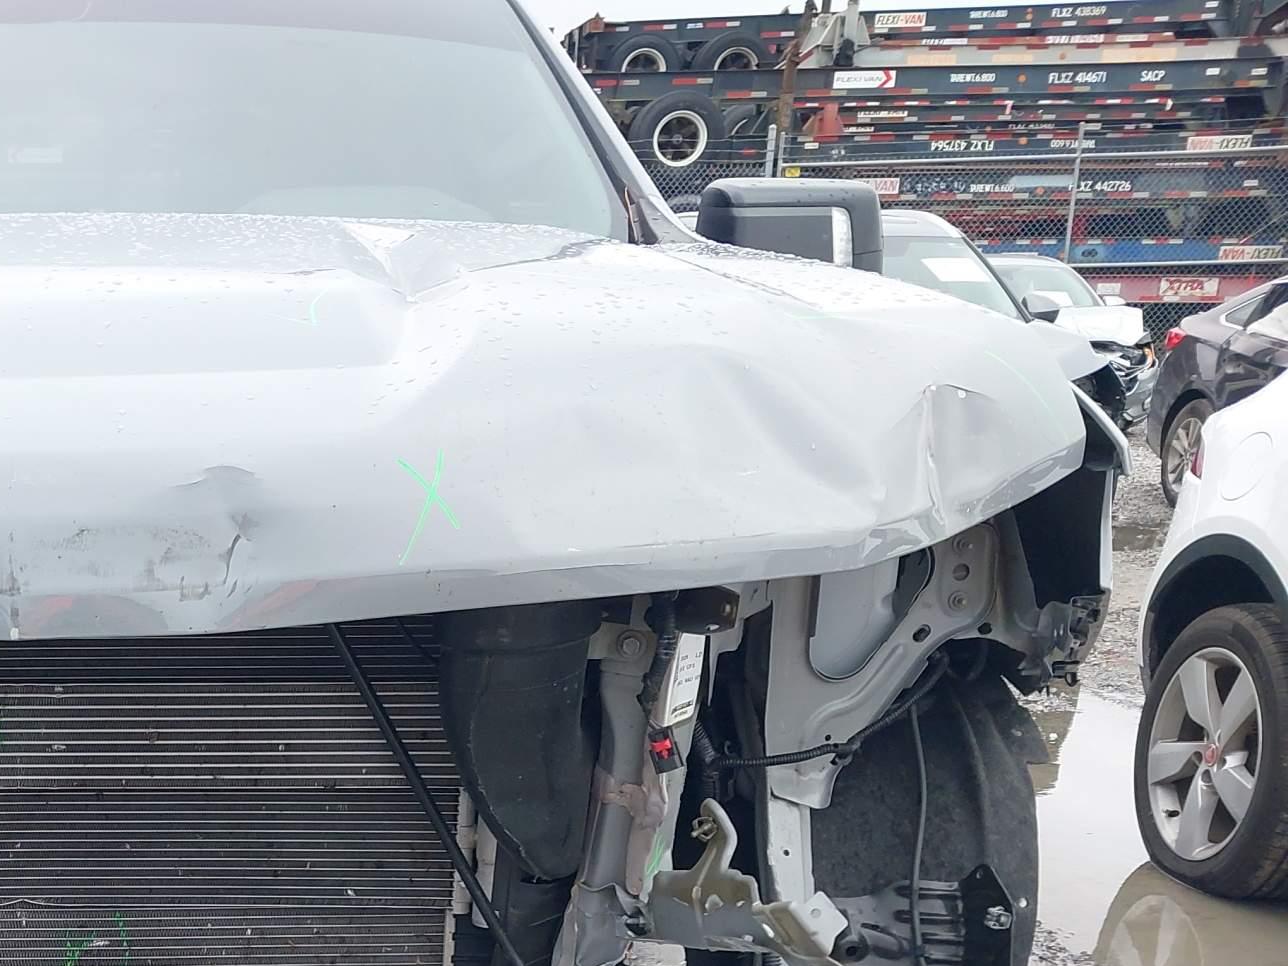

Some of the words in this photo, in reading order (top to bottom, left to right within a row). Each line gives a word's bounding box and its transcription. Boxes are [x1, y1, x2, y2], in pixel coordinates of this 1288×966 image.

[876, 13, 925, 26] FLEXI-VAN
[1048, 72, 1073, 84] FLXZ
[1140, 69, 1166, 82] SACP
[969, 139, 995, 151] FLXZ
[1068, 180, 1092, 192] FXZ
[1094, 180, 1132, 192] 442726
